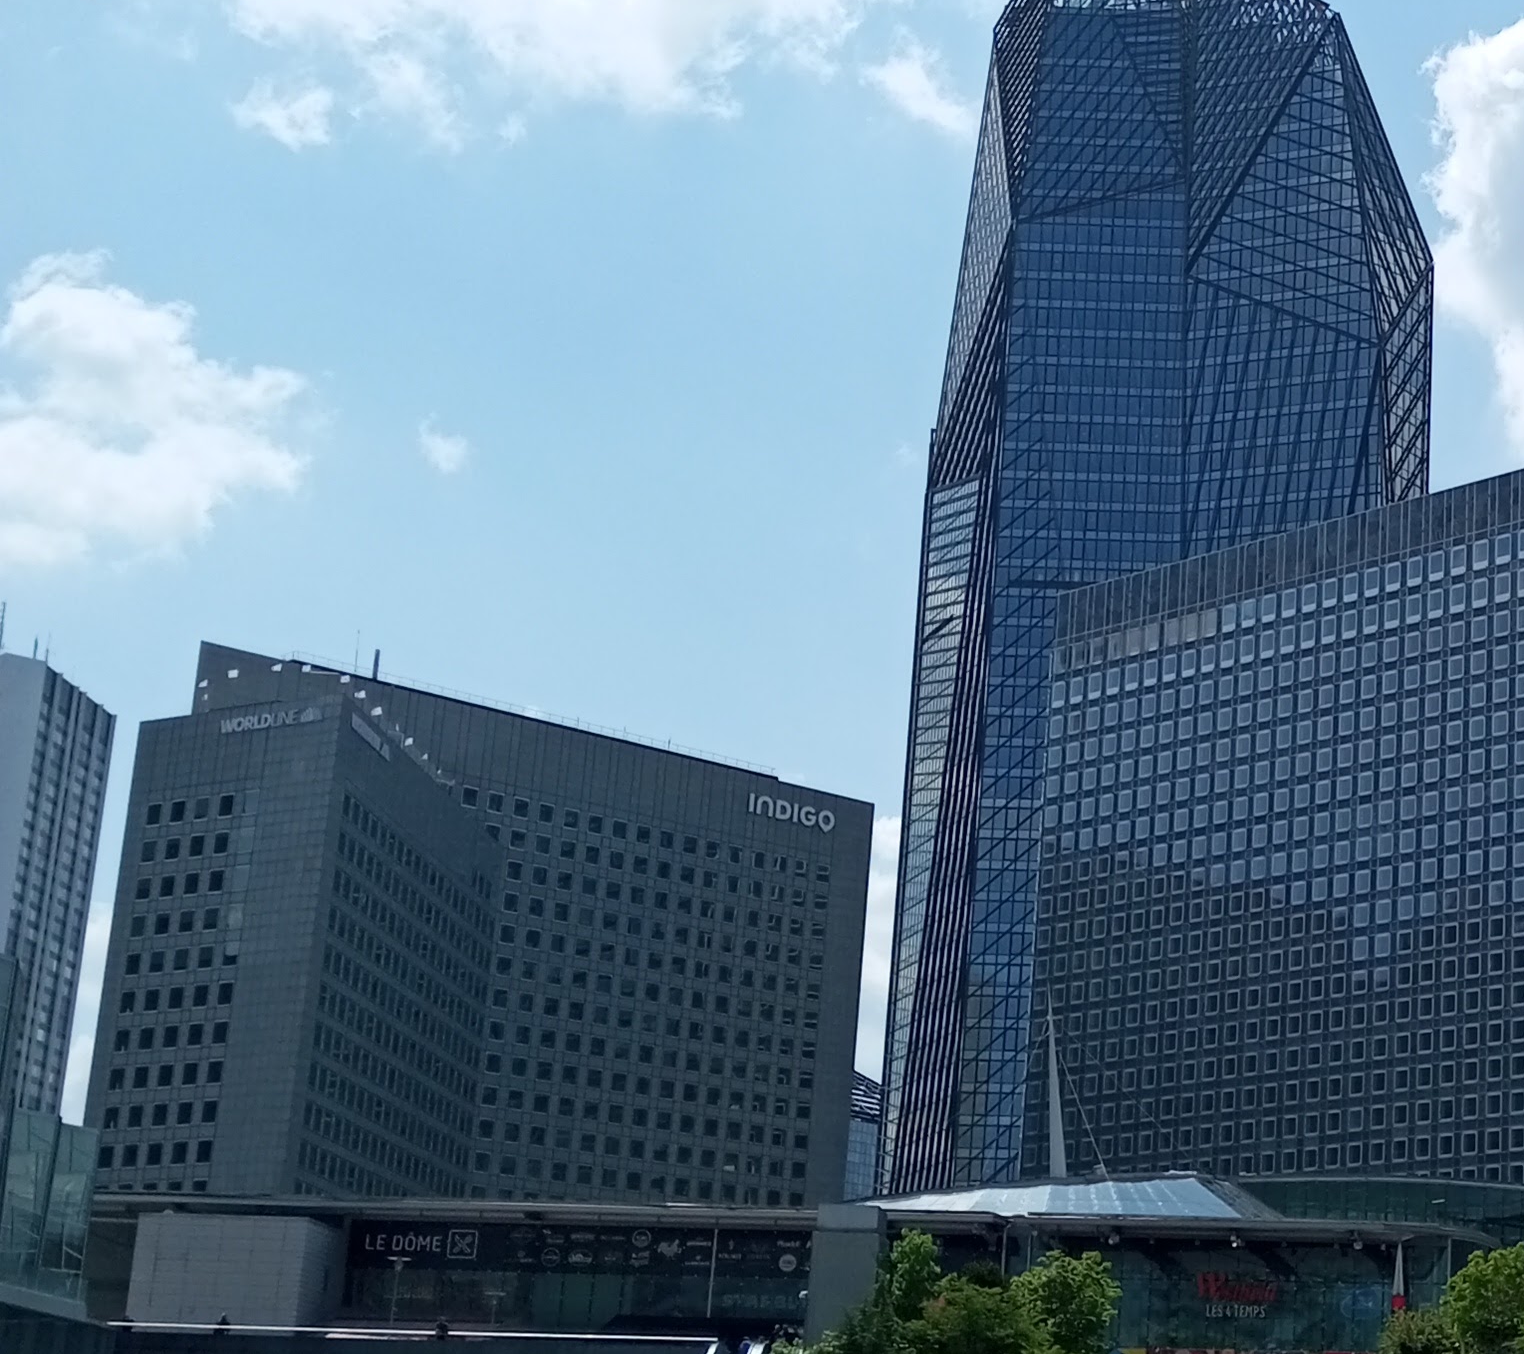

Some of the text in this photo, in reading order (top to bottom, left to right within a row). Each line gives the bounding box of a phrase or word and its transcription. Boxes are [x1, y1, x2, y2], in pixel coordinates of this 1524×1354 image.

[220, 709, 299, 734] WORLDLINE
[748, 792, 836, 833] INDIGO
[365, 1232, 442, 1252] LE DÔME
[1206, 1304, 1223, 1318] LES
[1234, 1304, 1267, 1318] TEMPS
